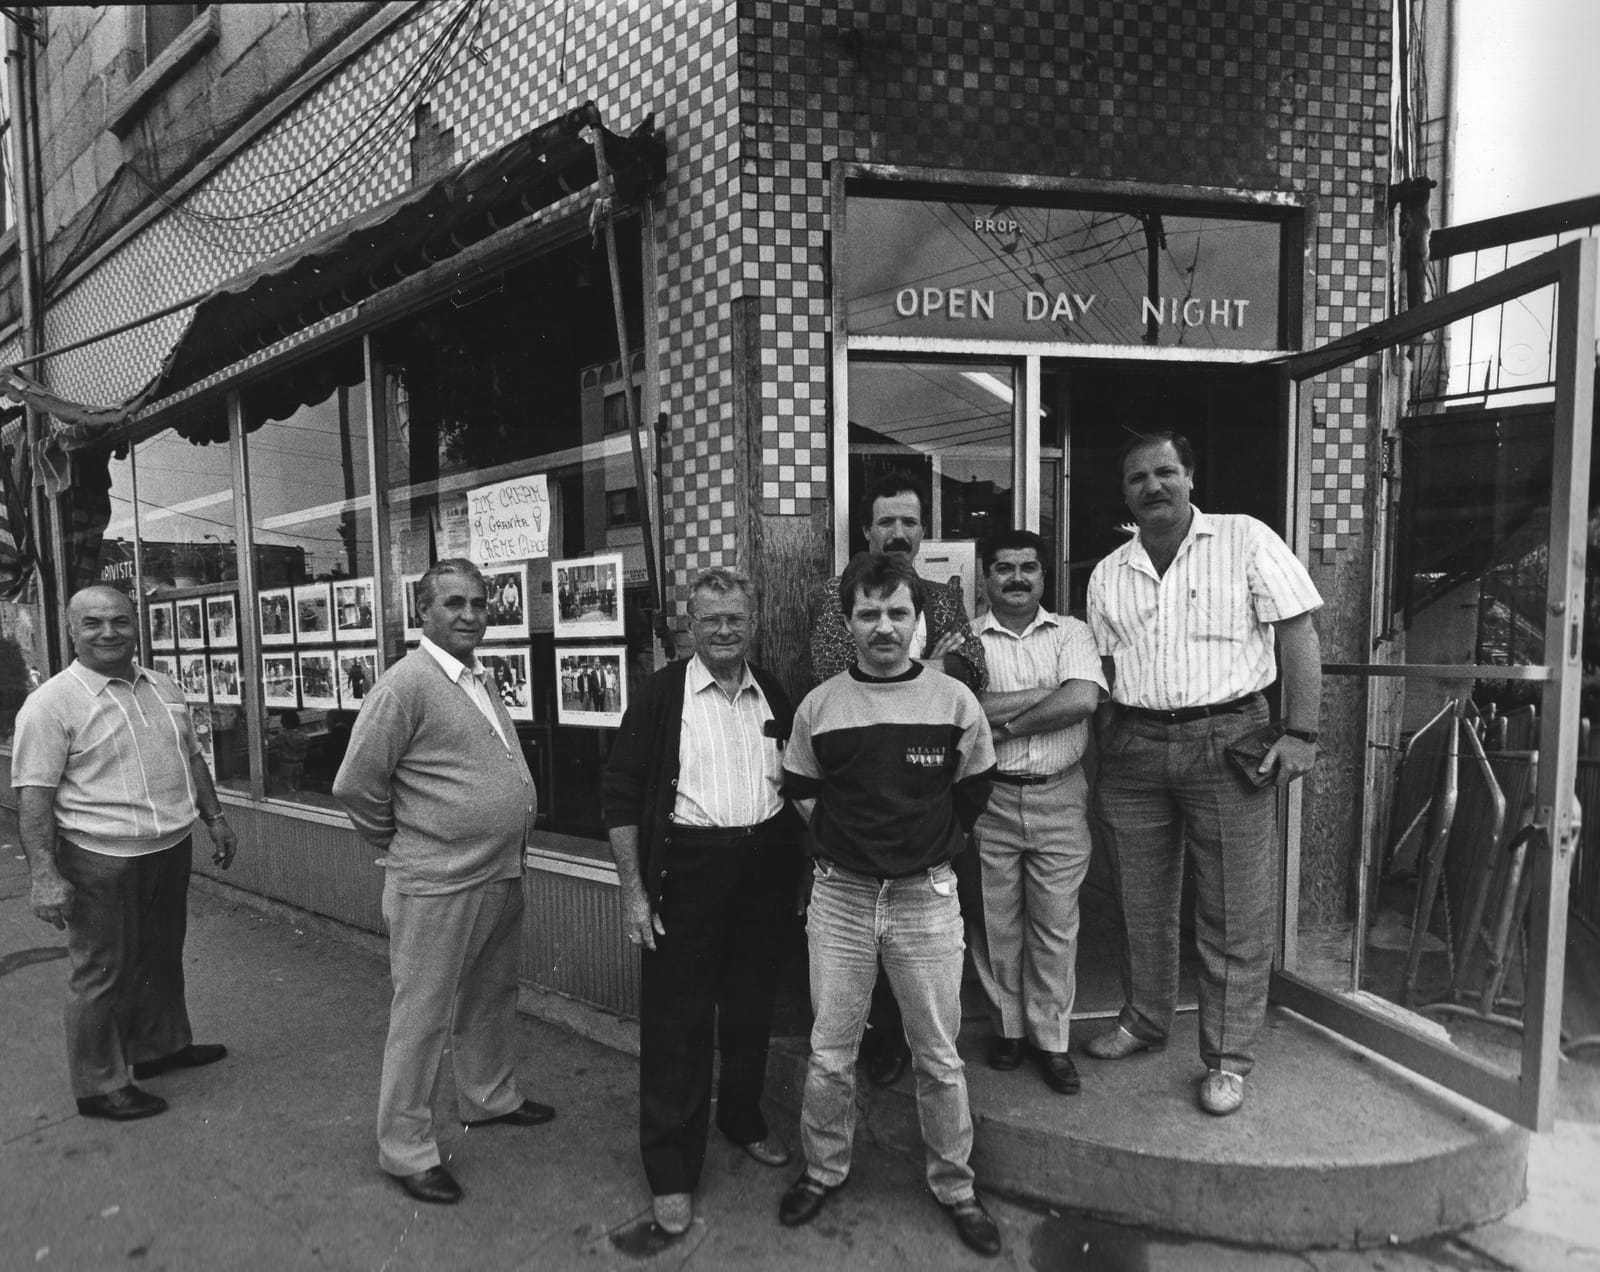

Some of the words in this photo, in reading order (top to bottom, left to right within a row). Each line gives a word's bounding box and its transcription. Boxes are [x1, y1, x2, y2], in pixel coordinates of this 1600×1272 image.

[974, 218, 1024, 233] PROP.
[896, 286, 995, 320] OPEN
[1026, 290, 1097, 322] DAY
[1141, 296, 1250, 328] NIGHT
[472, 491, 495, 515] ICE
[499, 484, 547, 508] CREAM
[906, 746, 945, 754] MIAMI
